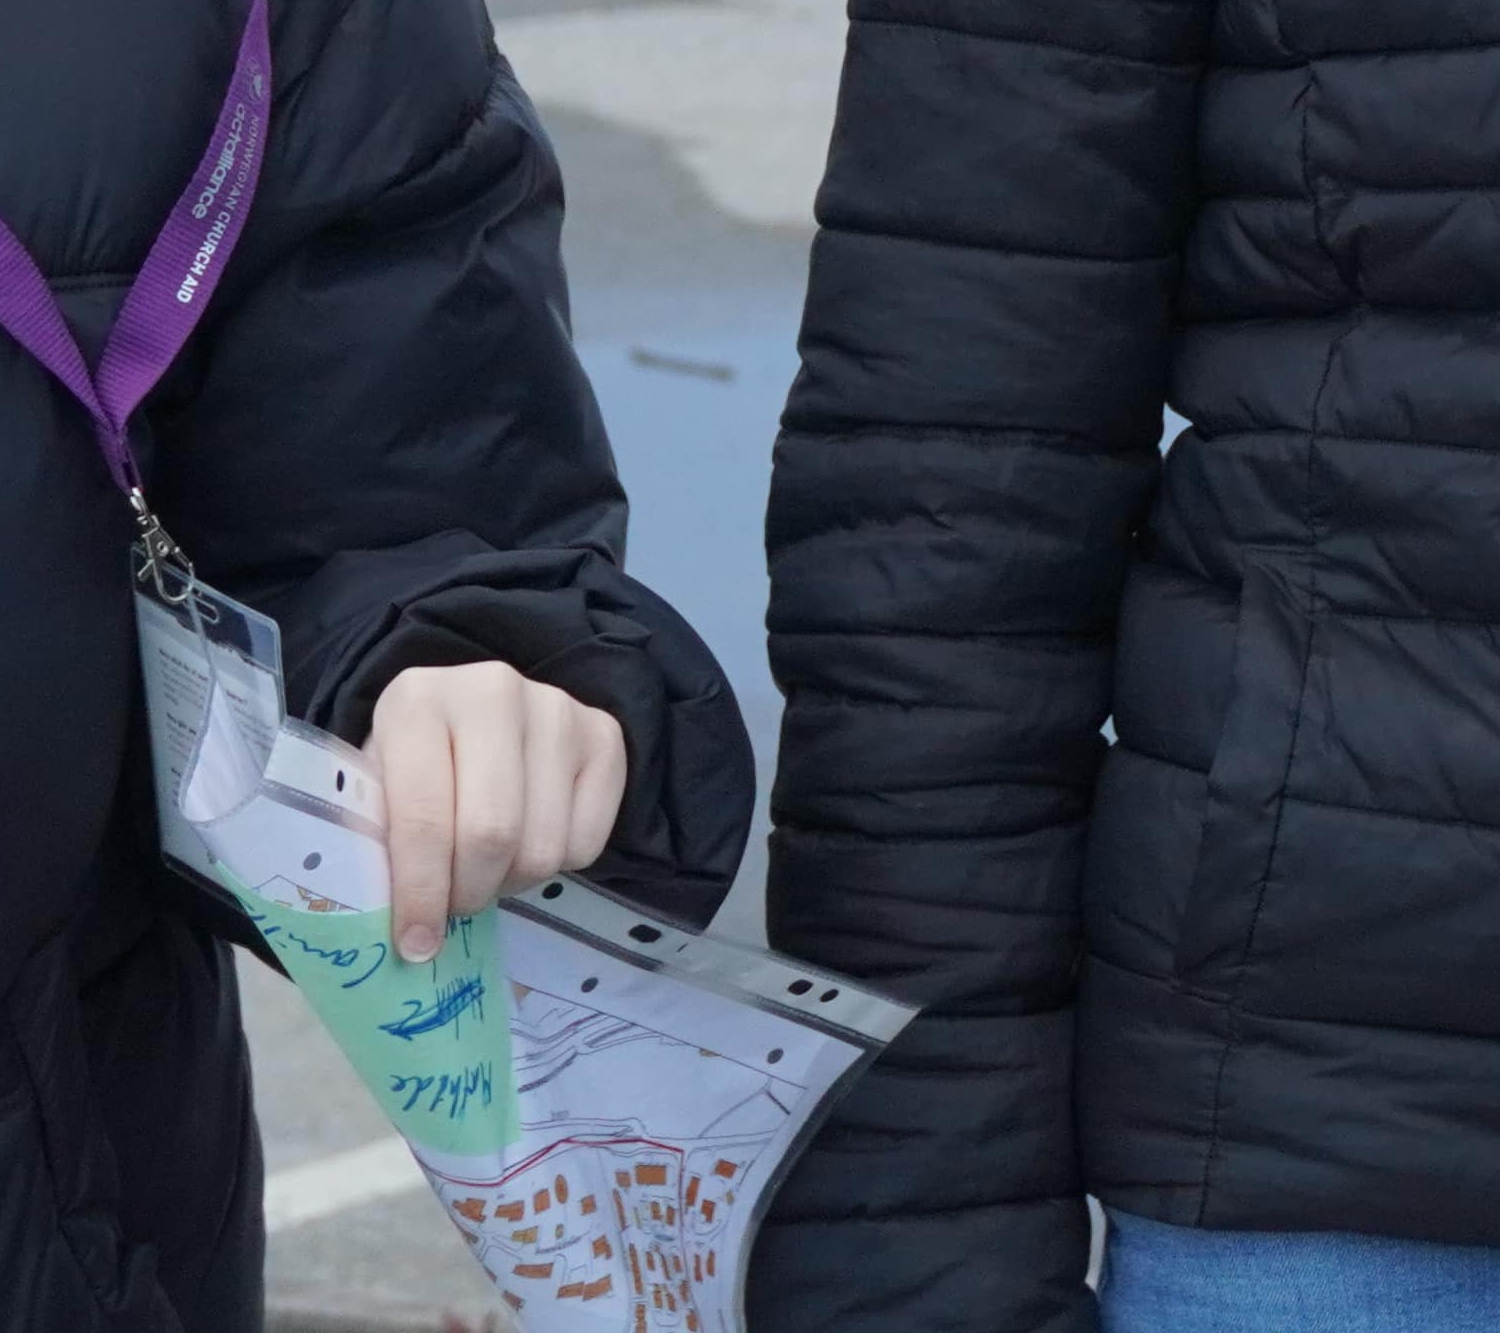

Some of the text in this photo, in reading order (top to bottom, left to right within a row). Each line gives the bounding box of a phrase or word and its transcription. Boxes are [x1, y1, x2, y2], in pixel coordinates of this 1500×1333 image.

[176, 116, 260, 304] NORWEGIAN CHURCH AID
[191, 102, 245, 220] actalliance
